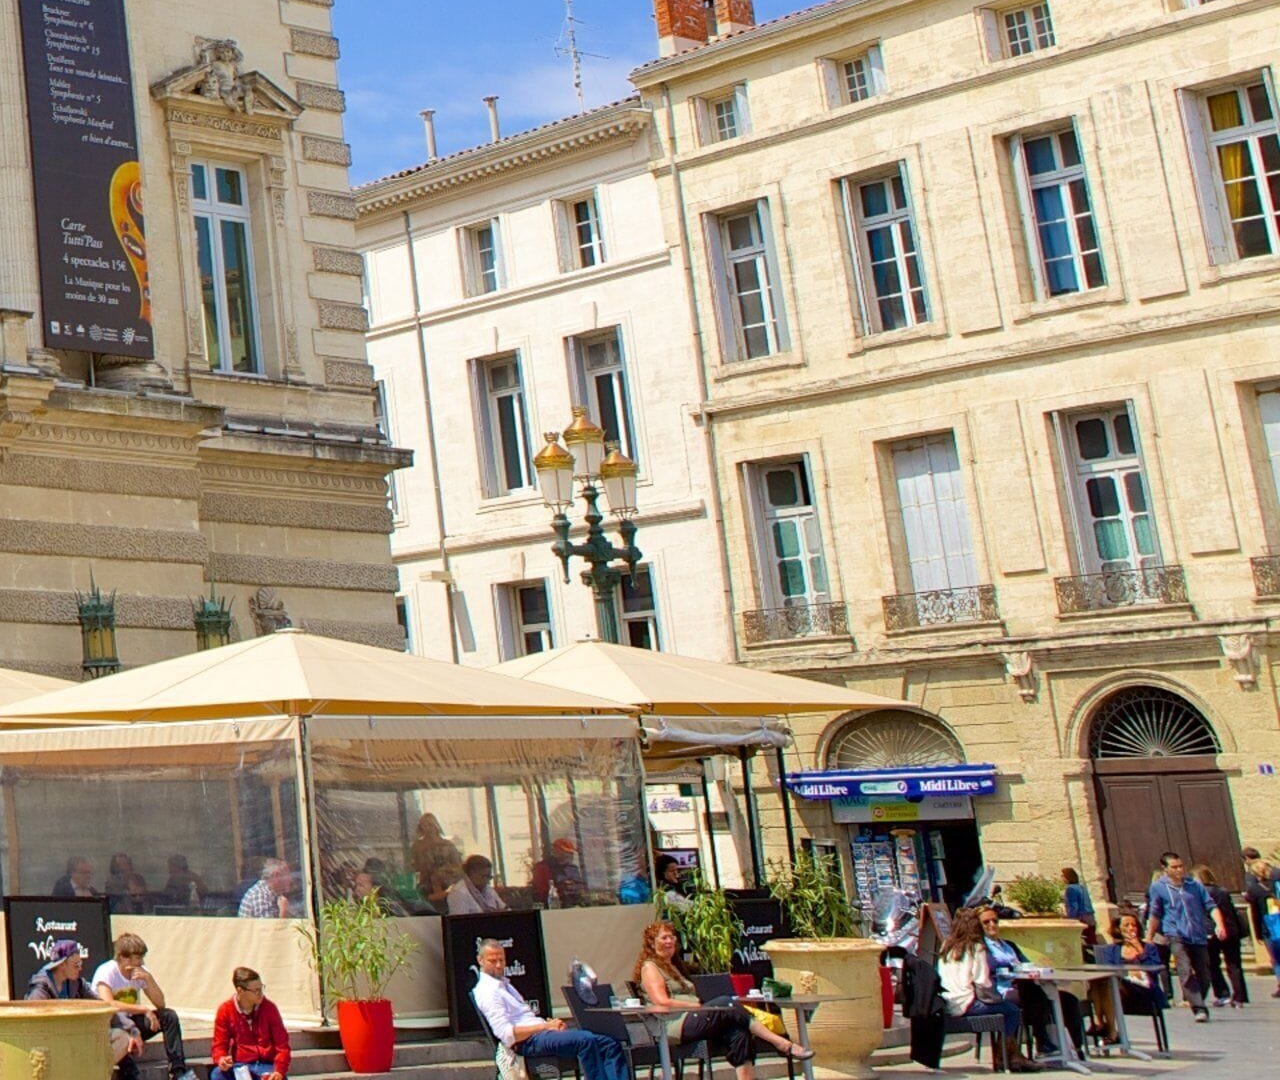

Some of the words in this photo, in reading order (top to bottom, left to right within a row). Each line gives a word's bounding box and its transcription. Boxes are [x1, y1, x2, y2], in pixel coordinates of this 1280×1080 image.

[61, 217, 86, 232] Carte
[62, 252, 69, 264] 4
[70, 257, 110, 269] spectacles
[64, 274, 73, 285] La
[794, 784, 818, 796] Midi
[819, 783, 848, 796] Libre
[919, 780, 945, 792] Midi
[946, 779, 979, 792] Libre
